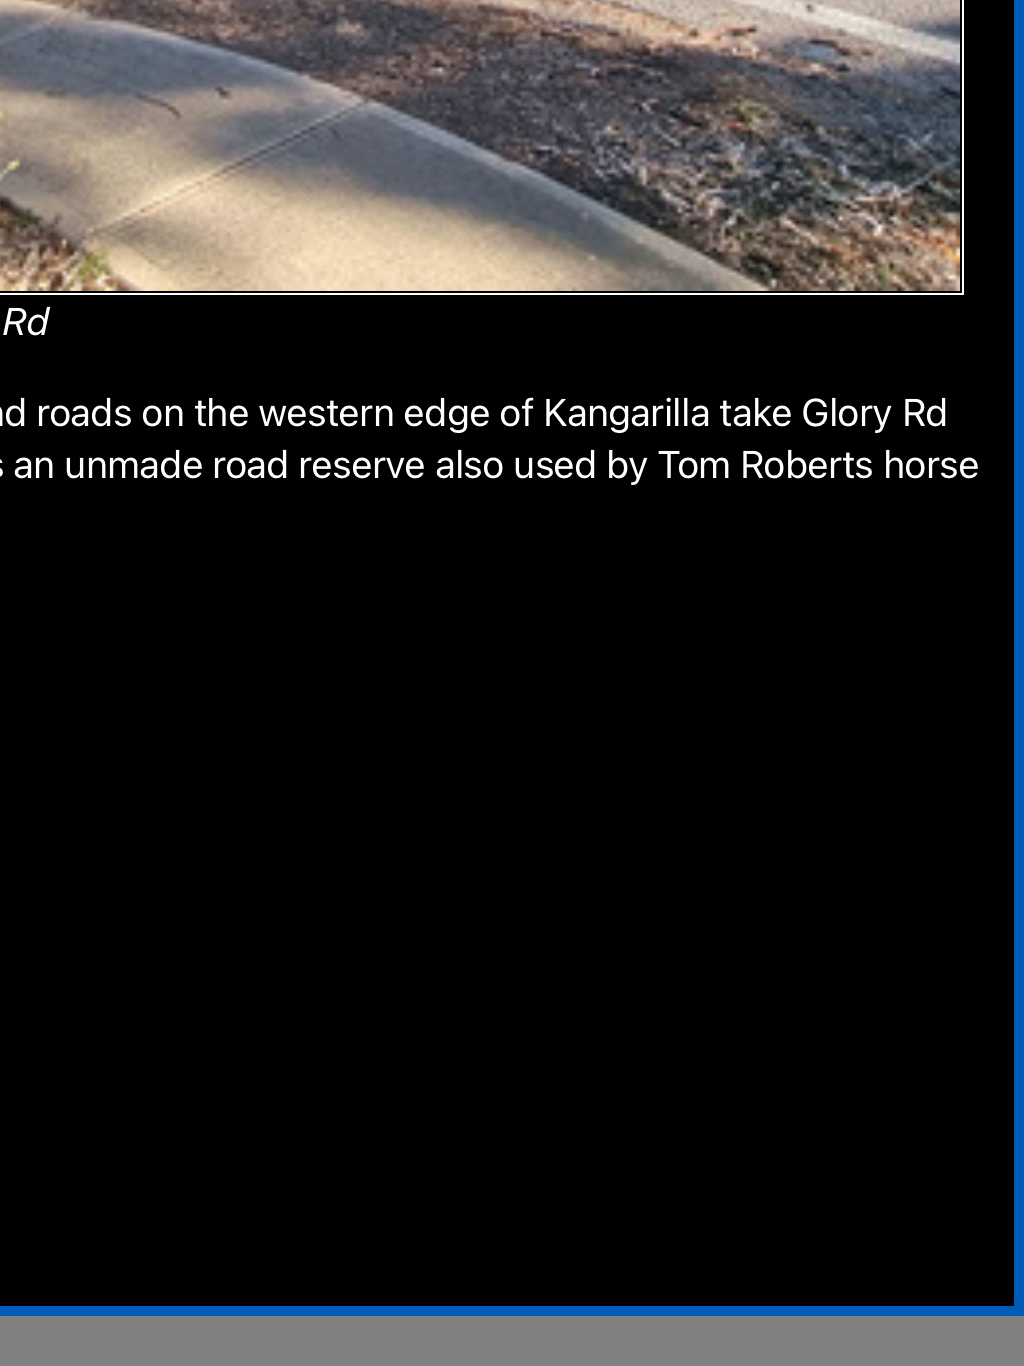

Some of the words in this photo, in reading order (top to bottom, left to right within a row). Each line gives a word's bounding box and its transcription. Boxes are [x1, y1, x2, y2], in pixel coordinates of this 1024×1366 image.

[3, 307, 50, 336] Rd
[39, 398, 131, 426] roads
[143, 405, 183, 426] on
[195, 398, 248, 426] the
[259, 400, 393, 426] western
[405, 398, 489, 433] edge
[501, 398, 533, 426] of
[546, 398, 708, 433] Kangarilla
[720, 398, 791, 426] take
[803, 398, 891, 433] Glory
[905, 398, 945, 426] Rd
[15, 457, 53, 478] an
[66, 450, 202, 478] unmade
[215, 450, 286, 478] road
[301, 457, 424, 478] reserve
[437, 450, 503, 478] also
[516, 450, 594, 478] used
[609, 450, 647, 485] by
[659, 451, 728, 478] Tom
[743, 450, 872, 478] Roberts
[886, 450, 978, 478] horse
